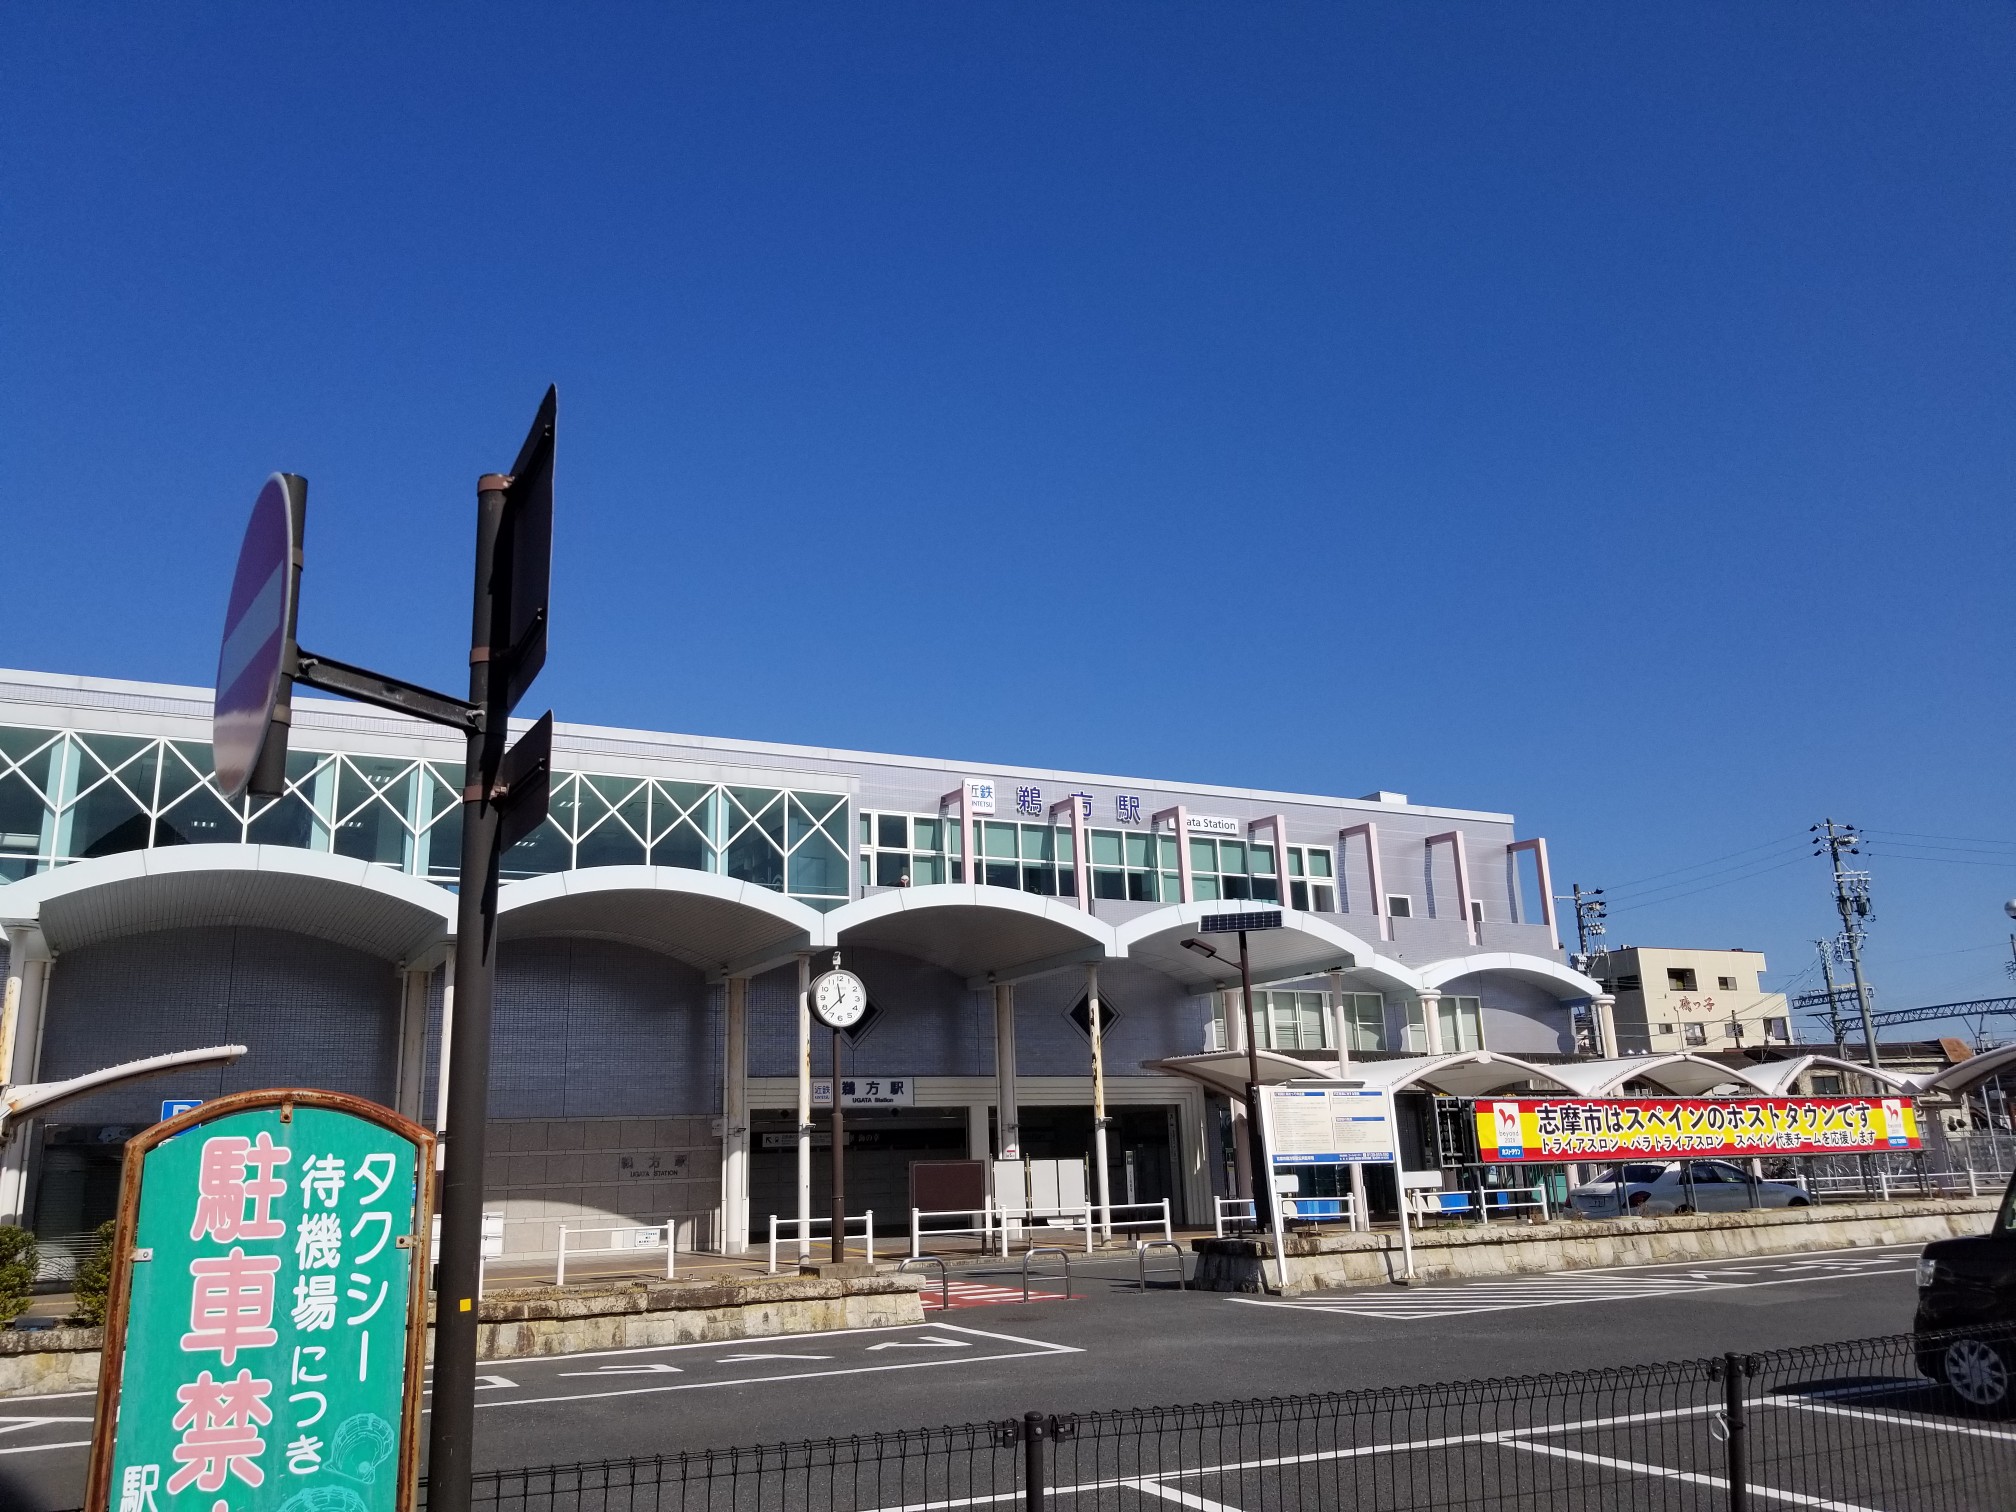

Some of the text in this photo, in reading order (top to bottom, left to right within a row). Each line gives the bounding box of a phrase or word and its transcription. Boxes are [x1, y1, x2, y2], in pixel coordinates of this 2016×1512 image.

[972, 800, 993, 808] INTETSU
[1187, 818, 1236, 830] ata Station
[1535, 1100, 1872, 1136] 志摩市はスペインのホストタウンです
[1734, 1129, 1876, 1148] スペイン代表チームを応援します
[653, 1169, 678, 1177] STATION
[347, 1152, 397, 1382] タクシー
[165, 1131, 292, 1512] 駐車禁
[285, 1153, 346, 1476] 待機場につき
